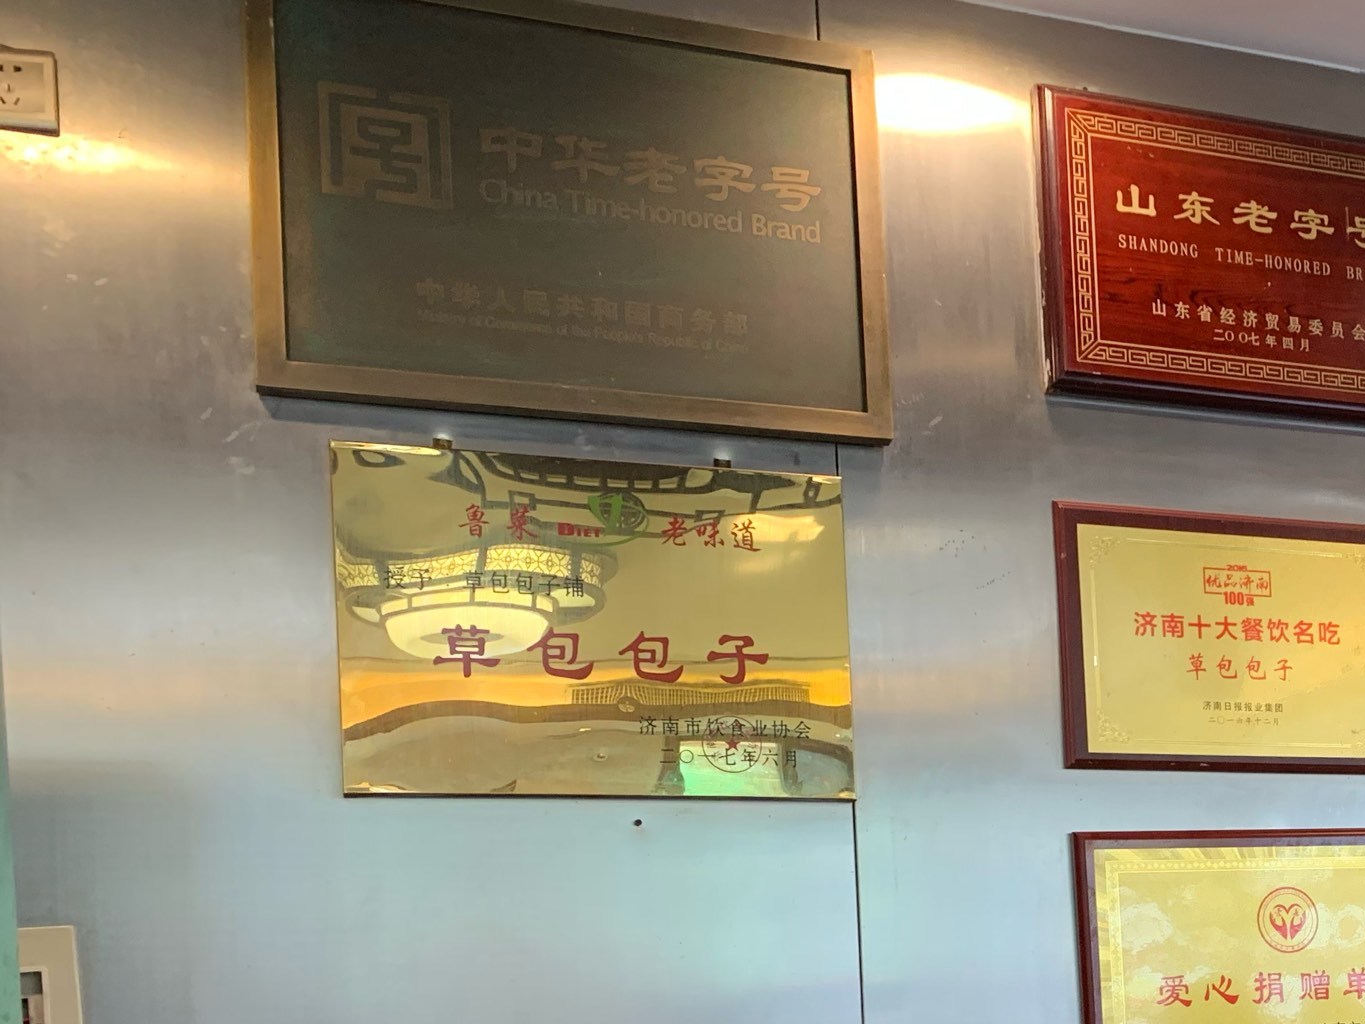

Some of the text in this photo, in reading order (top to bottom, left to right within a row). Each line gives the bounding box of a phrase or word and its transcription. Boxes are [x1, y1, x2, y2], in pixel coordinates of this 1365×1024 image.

[479, 126, 821, 212] 中华老字号
[478, 179, 557, 210] China
[752, 214, 822, 244] Brand
[1118, 234, 1199, 258] SHANDONG
[1215, 247, 1331, 276] TIME-HONORED
[458, 503, 539, 541] 鲁菜
[660, 516, 762, 552] 老味道
[464, 570, 586, 599] 草包包子铺
[1223, 591, 1255, 607] 100强
[1133, 611, 1341, 645] 济南十大餐饮名吃
[433, 623, 770, 685] 草包包子
[1186, 653, 1294, 681] 草包包子
[1202, 700, 1284, 713] 济南日报报业集团
[638, 715, 812, 740] 济南市饮食业协会
